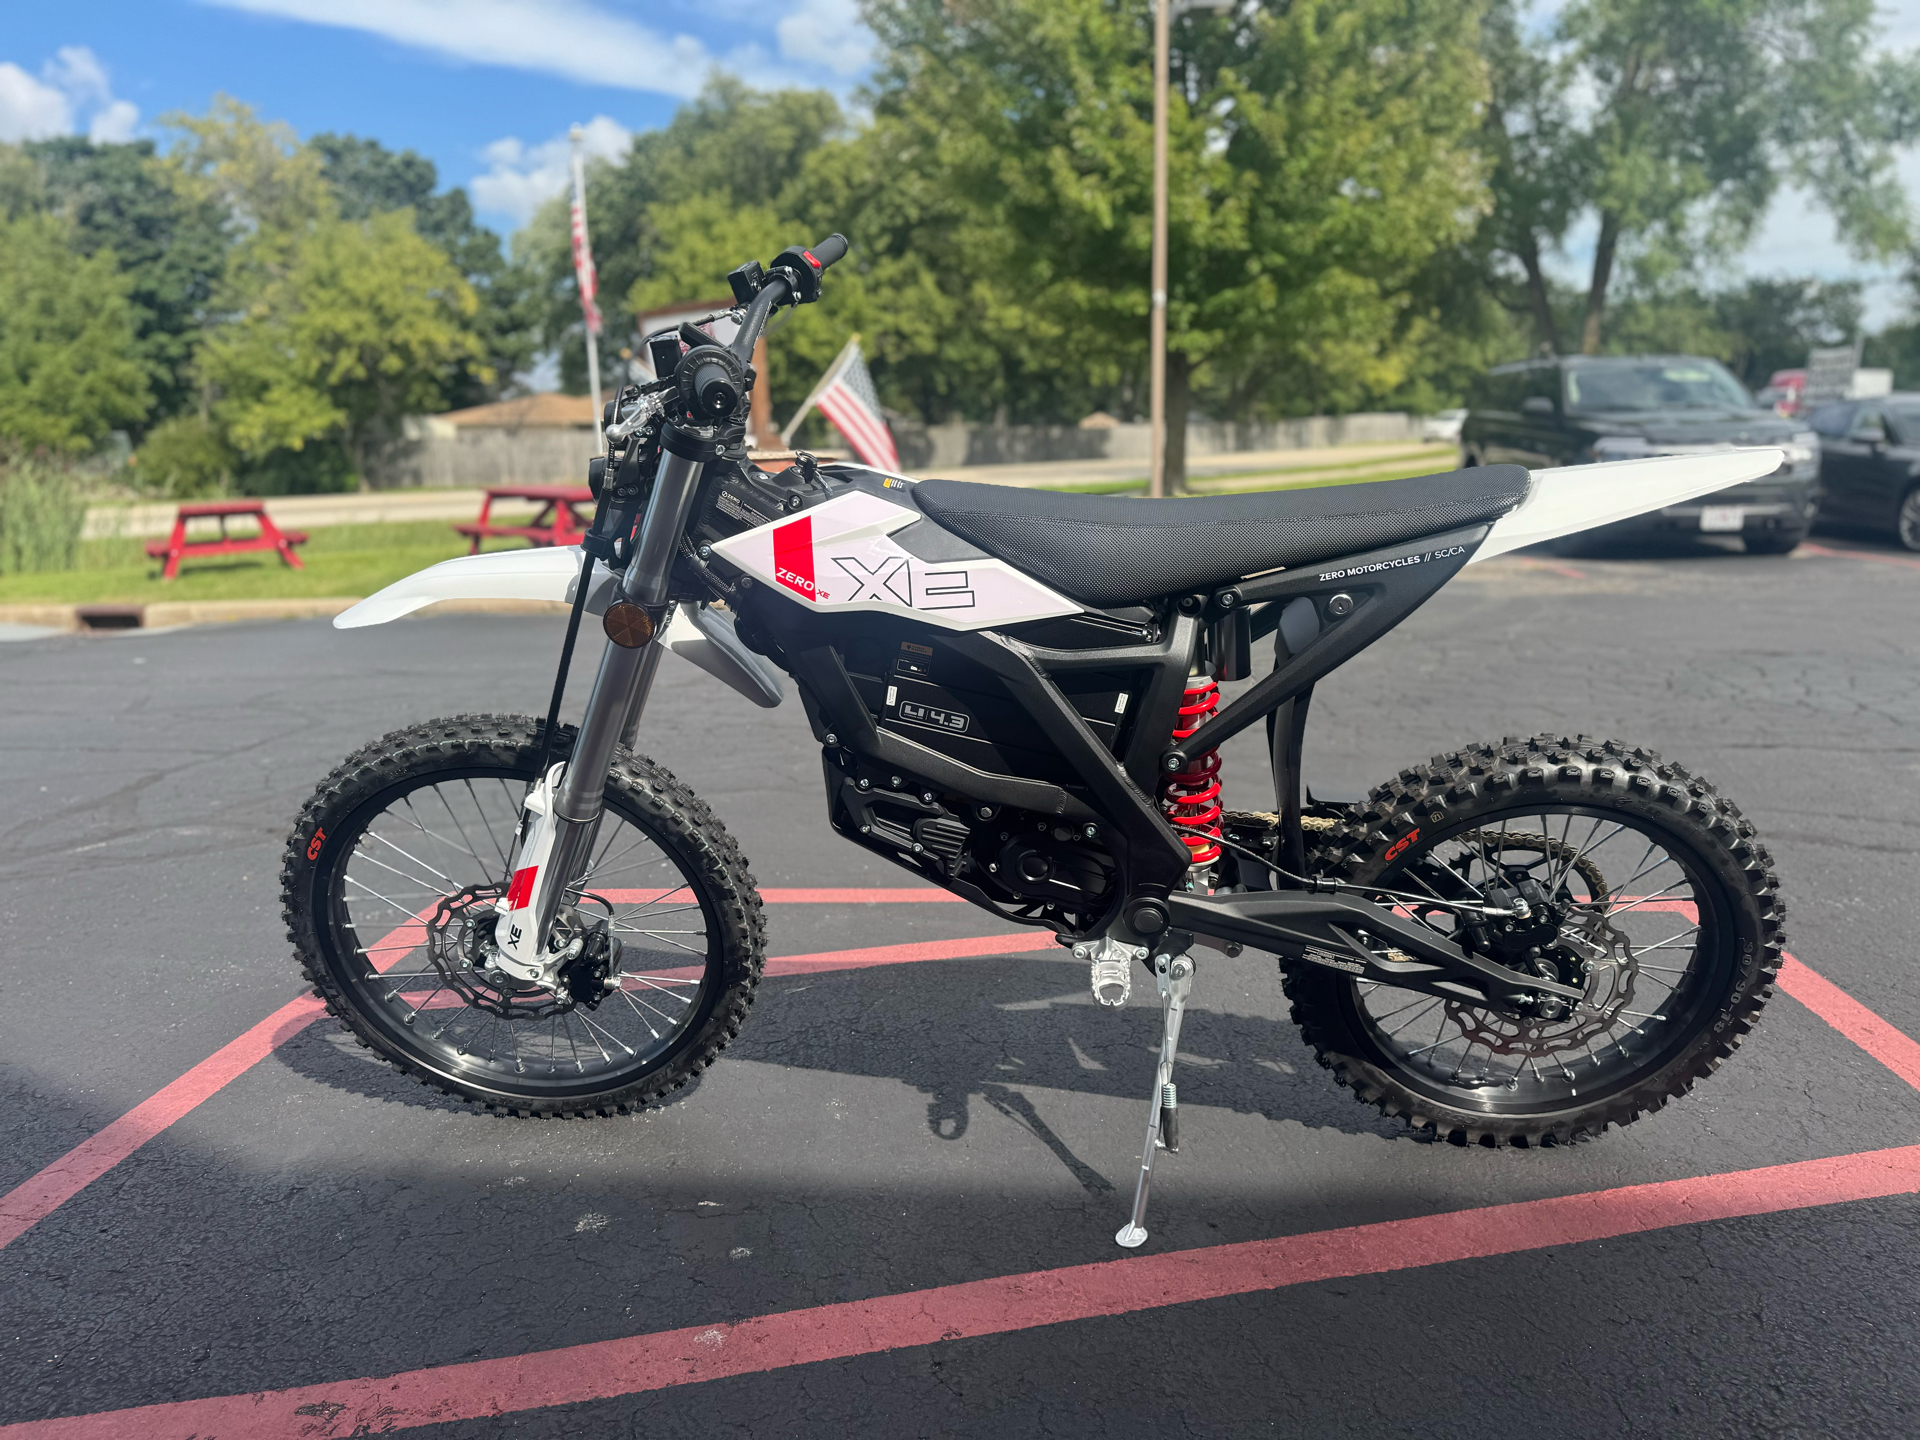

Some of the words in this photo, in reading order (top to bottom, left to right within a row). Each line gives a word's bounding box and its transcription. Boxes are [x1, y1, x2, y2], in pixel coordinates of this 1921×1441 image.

[1319, 569, 1346, 582] ZERO
[1347, 556, 1421, 577] MOTORCYCLES
[1434, 545, 1466, 559] SC/CA
[775, 567, 815, 592] ZERO
[816, 588, 830, 600] XE
[831, 556, 976, 610] XE
[930, 710, 965, 729] 4.3
[307, 826, 327, 861] CST
[1384, 827, 1420, 861] CST
[507, 923, 523, 951] XE
